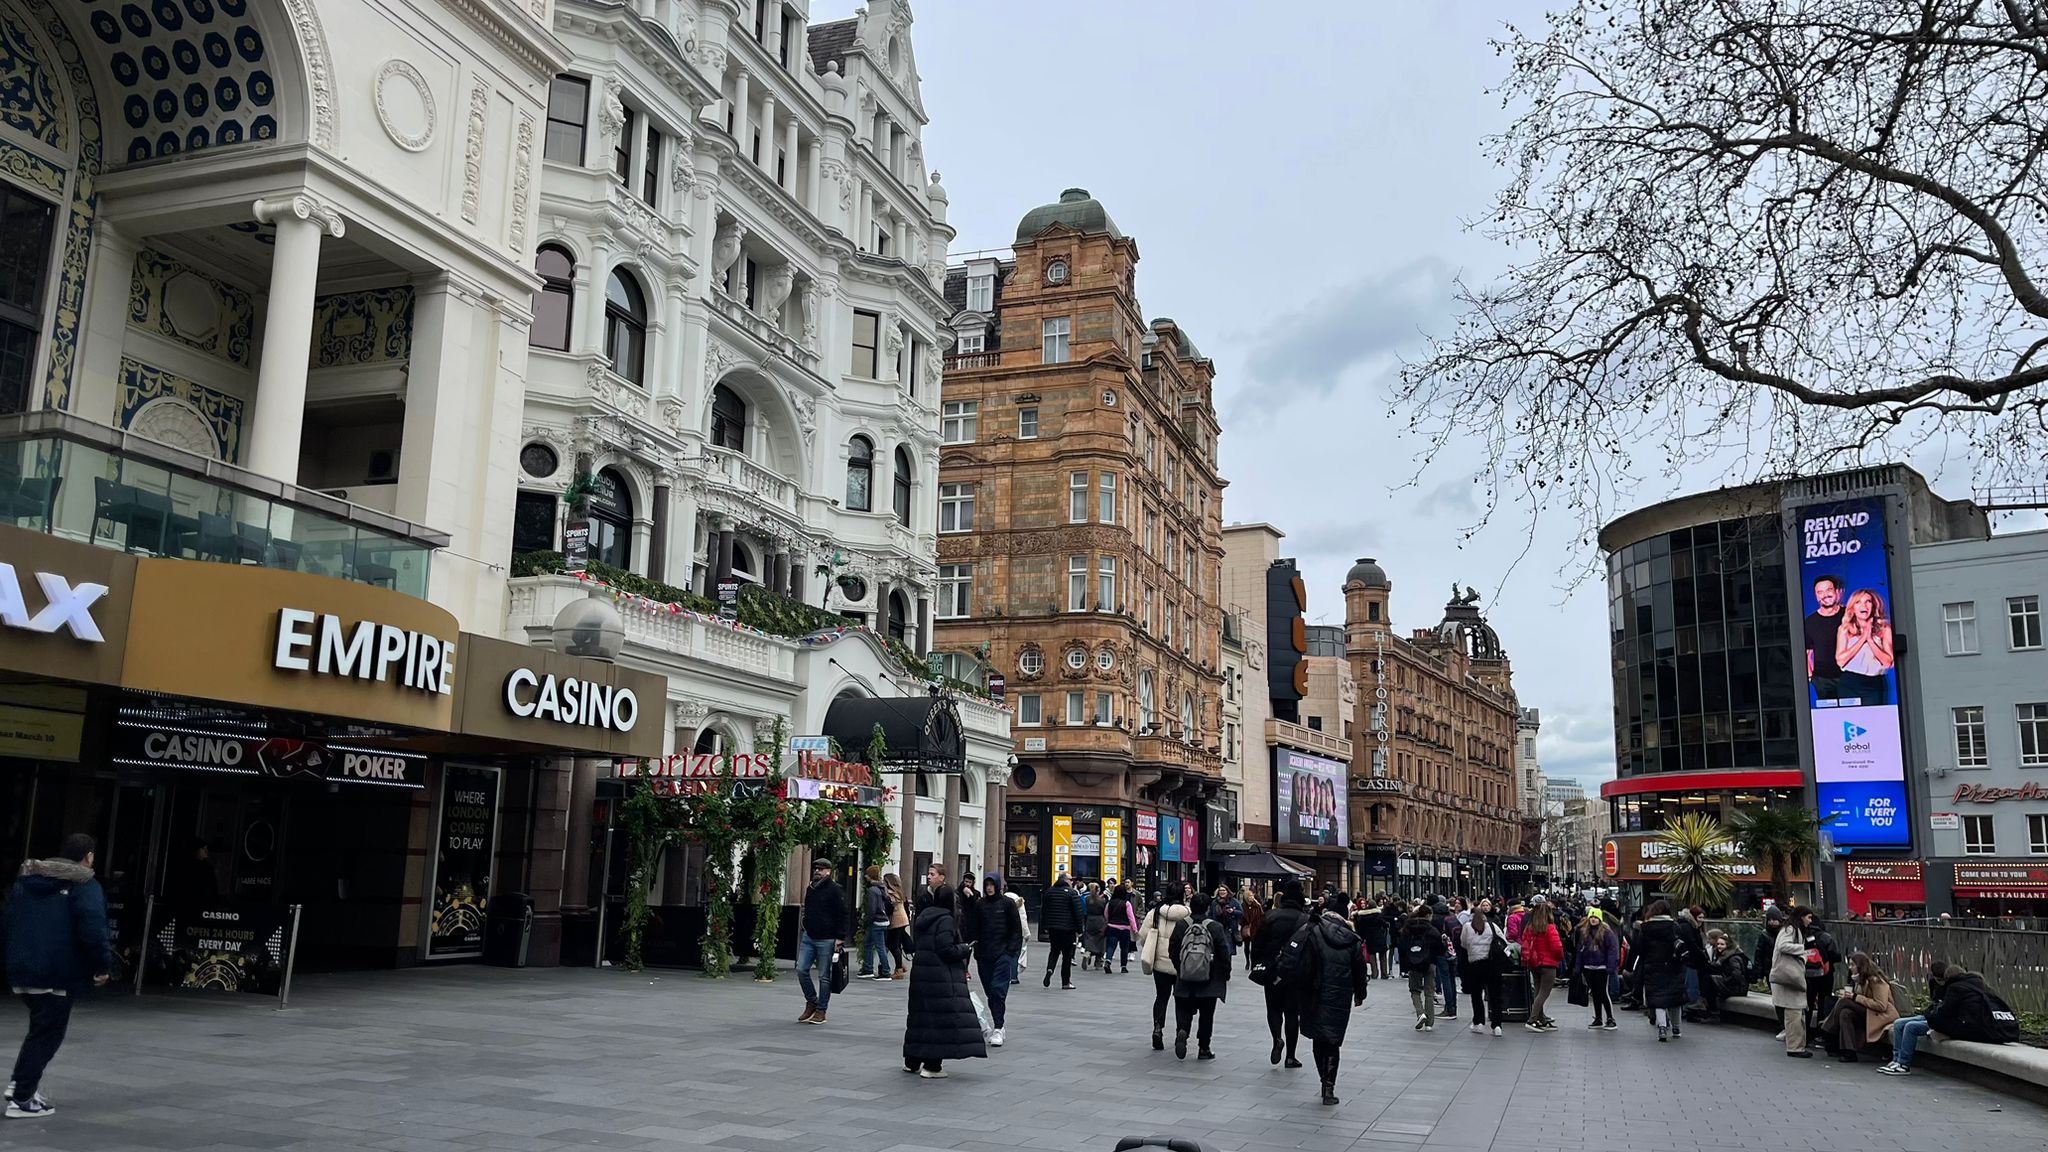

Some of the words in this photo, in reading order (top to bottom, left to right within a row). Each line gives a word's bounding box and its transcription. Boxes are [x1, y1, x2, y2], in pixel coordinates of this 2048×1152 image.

[591, 494, 617, 507] ALCONY
[1804, 512, 1869, 533] REWIND
[566, 528, 588, 538] SPORTS
[1805, 529, 1839, 545] LIVE
[1805, 539, 1862, 558] RADIO
[275, 608, 455, 696] EMPIRE
[928, 664, 943, 672] BIG
[507, 668, 639, 733] CASINO
[1374, 631, 1389, 771] HIPPODROME
[144, 732, 243, 766] CASINO
[792, 738, 827, 748] LITE
[1844, 742, 1871, 753] global
[343, 753, 406, 780] POKER
[454, 790, 485, 805] WHERE
[1952, 783, 2014, 805] Pizza
[1869, 798, 1890, 807] FOR
[448, 806, 489, 820] LONDON
[1864, 807, 1896, 817] EVERY
[449, 821, 485, 835] COMES
[1870, 817, 1893, 827] YOU
[449, 836, 461, 849] TO
[462, 837, 484, 850] PLAY
[1641, 841, 1689, 858] BURGE
[1501, 863, 1529, 871] CASINO
[1731, 865, 1756, 875] 1954
[1852, 866, 1874, 874] Pizza
[1875, 866, 1891, 874] Hut
[1980, 891, 2046, 899] RESTAURANT
[202, 911, 239, 921] CASINO
[186, 926, 210, 938] OPEN
[211, 928, 223, 938] 24
[225, 929, 255, 941] HOURS
[198, 939, 223, 950] EVERY
[224, 940, 242, 952] DAY
